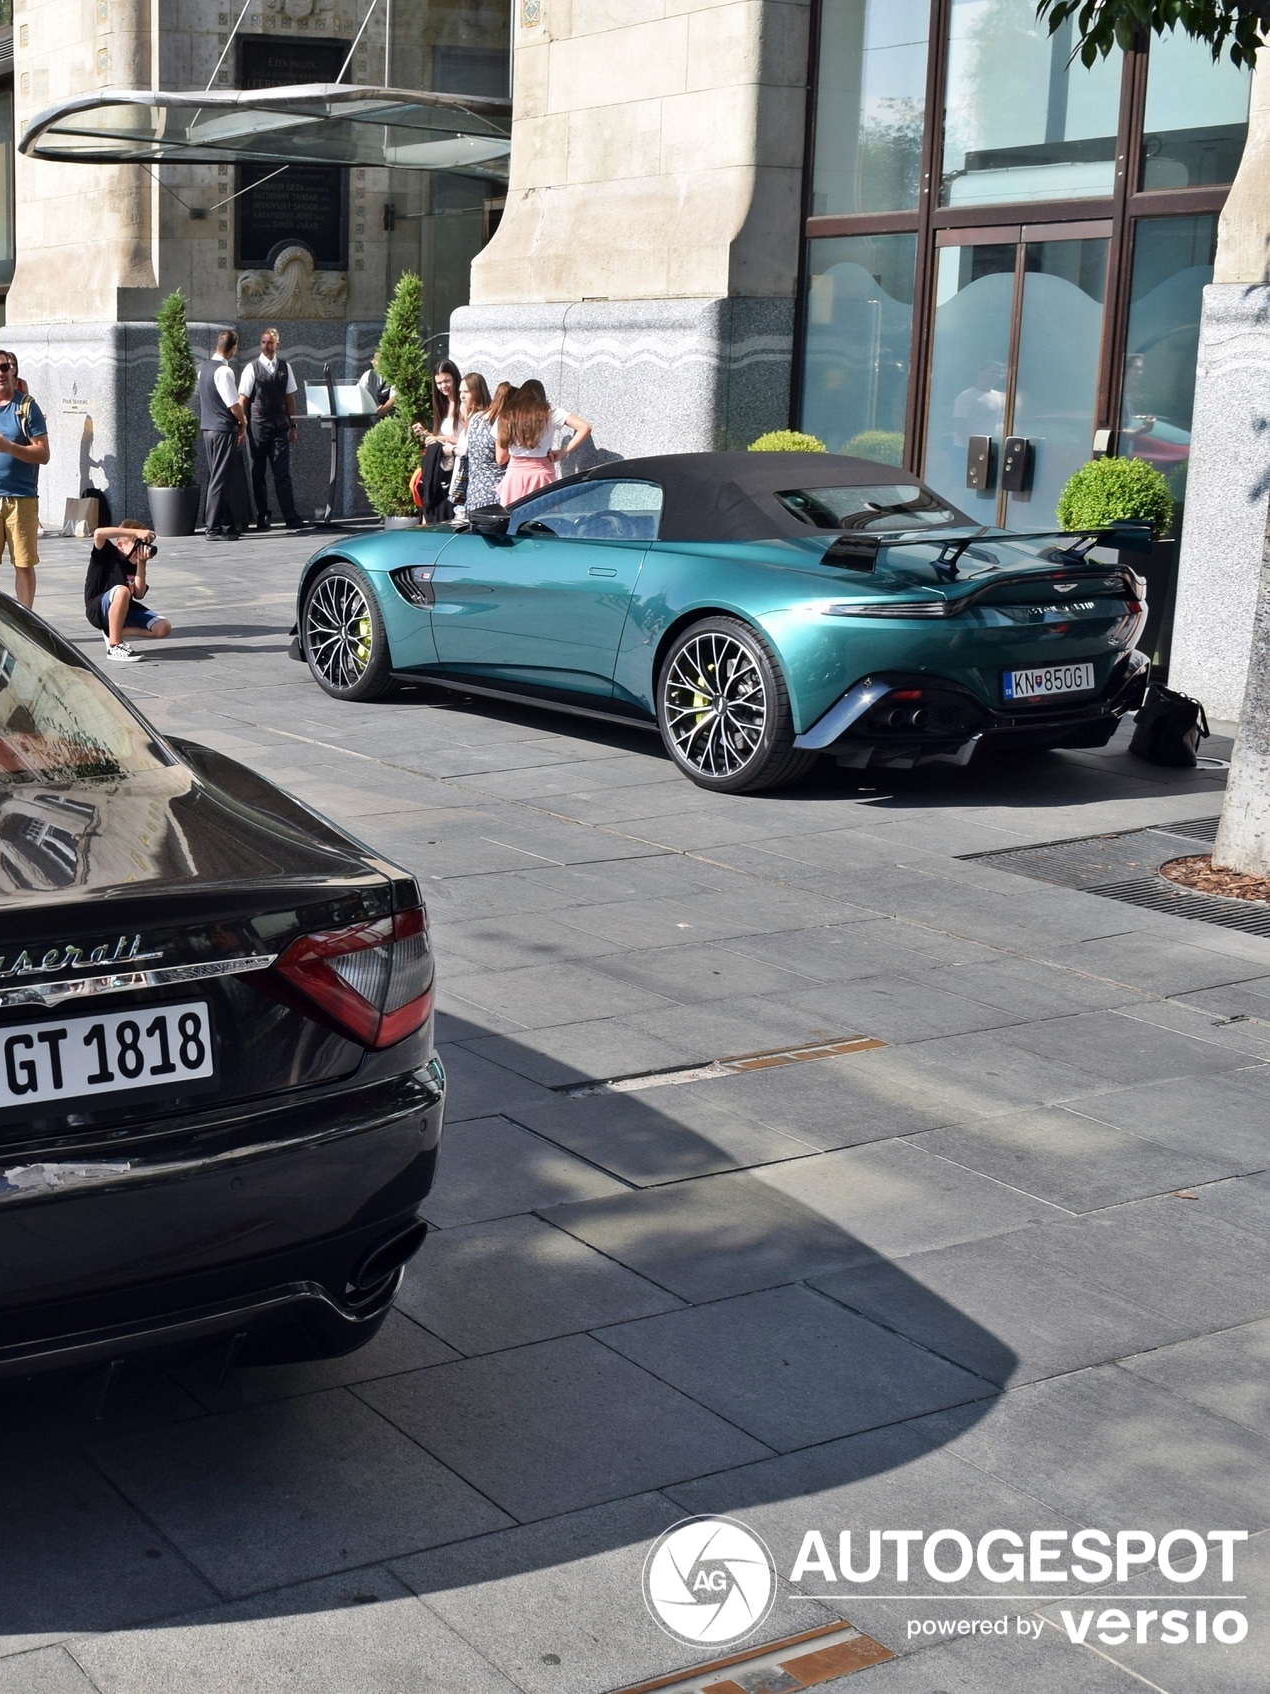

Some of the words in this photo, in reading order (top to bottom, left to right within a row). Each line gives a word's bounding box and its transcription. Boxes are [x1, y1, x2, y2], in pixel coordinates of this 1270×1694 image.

[1027, 605, 1058, 615] ASTON
[1061, 601, 1095, 612] MARTIN
[1014, 671, 1035, 695] KN
[1044, 665, 1090, 691] 850GI
[3, 1028, 68, 1096] GT
[83, 1011, 206, 1086] 1818
